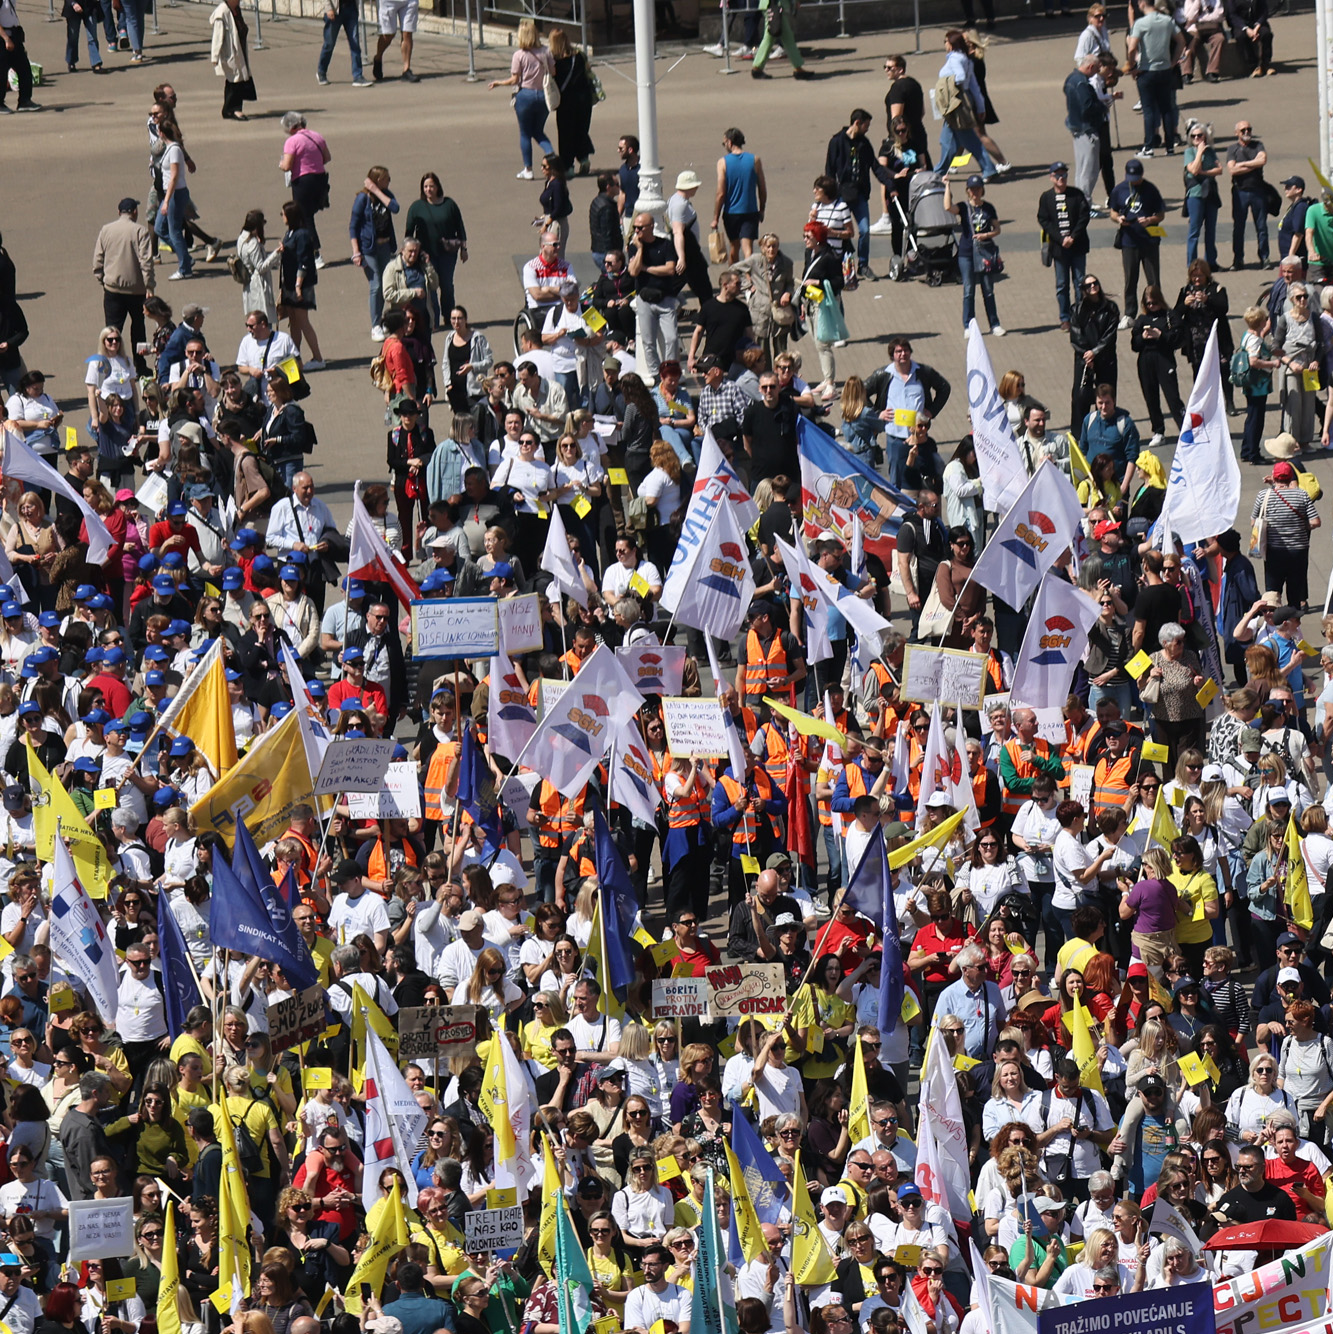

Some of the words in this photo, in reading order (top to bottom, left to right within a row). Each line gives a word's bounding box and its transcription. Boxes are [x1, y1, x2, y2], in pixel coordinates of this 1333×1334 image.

[1039, 635, 1072, 648] SGH
[638, 666, 664, 677] SGH
[567, 707, 604, 738] SGH
[666, 994, 698, 1004] PROTIV
[738, 996, 786, 1014] OTISAK
[416, 1007, 453, 1018] IZBOR
[654, 1000, 708, 1017] NEPRAVDE!
[269, 1012, 297, 1038] SMO
[298, 1000, 324, 1022] ZBOG
[402, 1032, 431, 1043] BRATI
[466, 1208, 523, 1225] TRETIRATE
[1114, 1300, 1194, 1330] POVEĆANJE
